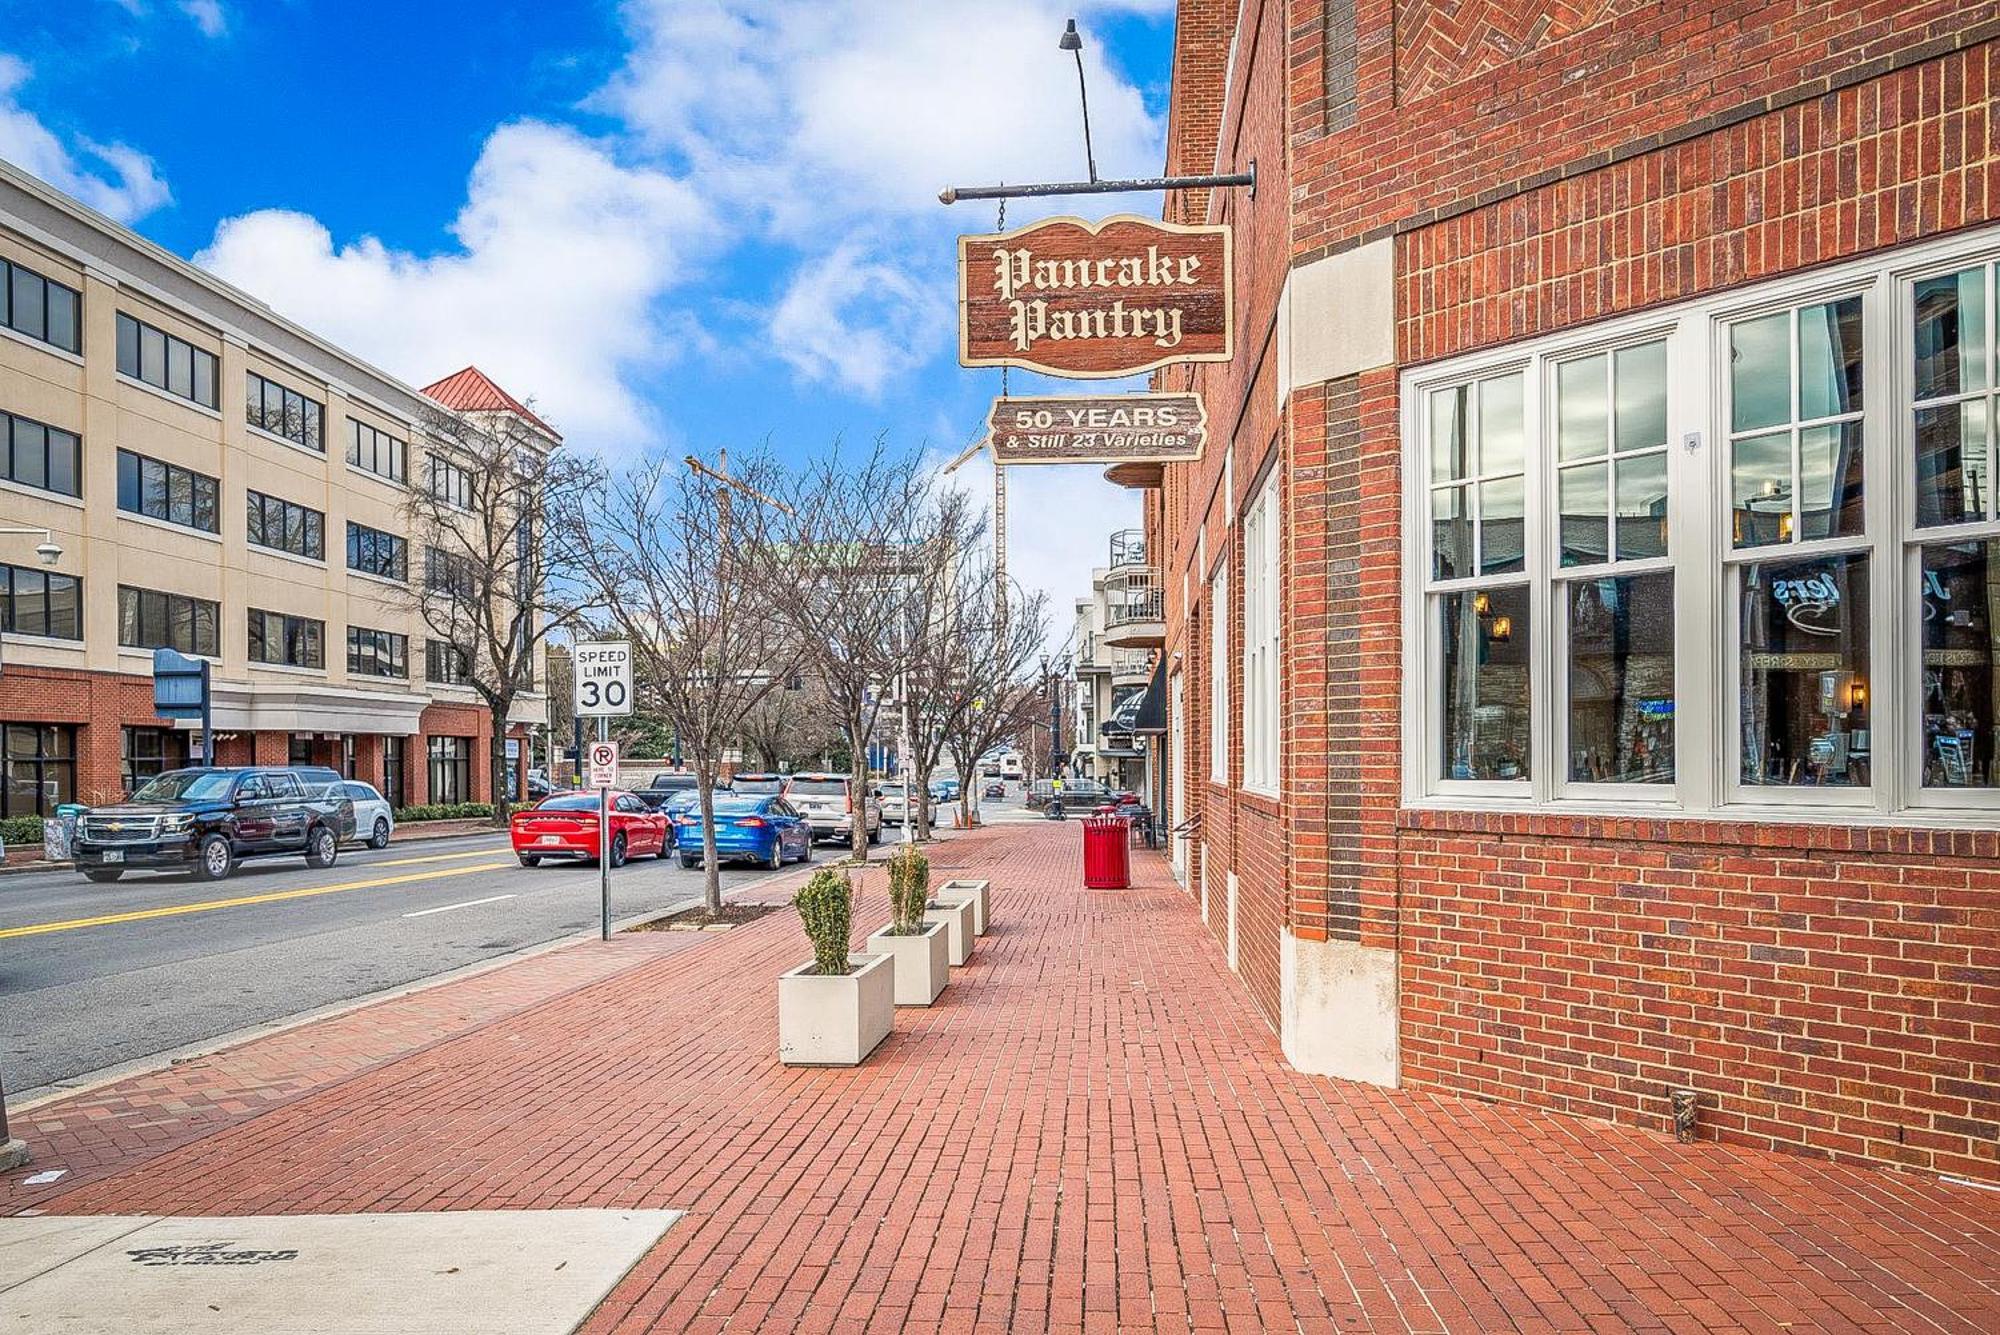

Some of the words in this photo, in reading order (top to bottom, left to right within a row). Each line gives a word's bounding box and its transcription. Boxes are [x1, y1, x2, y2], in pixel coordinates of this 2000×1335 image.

[992, 245, 1202, 301] Pancake
[1008, 299, 1183, 352] Pantry
[1015, 410, 1053, 429] 50
[1066, 407, 1178, 428] YEARS
[1006, 435, 1020, 447] &
[1028, 433, 1065, 448] Still
[1072, 433, 1095, 447] 23
[1103, 429, 1187, 447] Varieties
[578, 651, 627, 663] SPEED
[584, 666, 621, 678] LIMIT
[581, 681, 626, 707] 30
